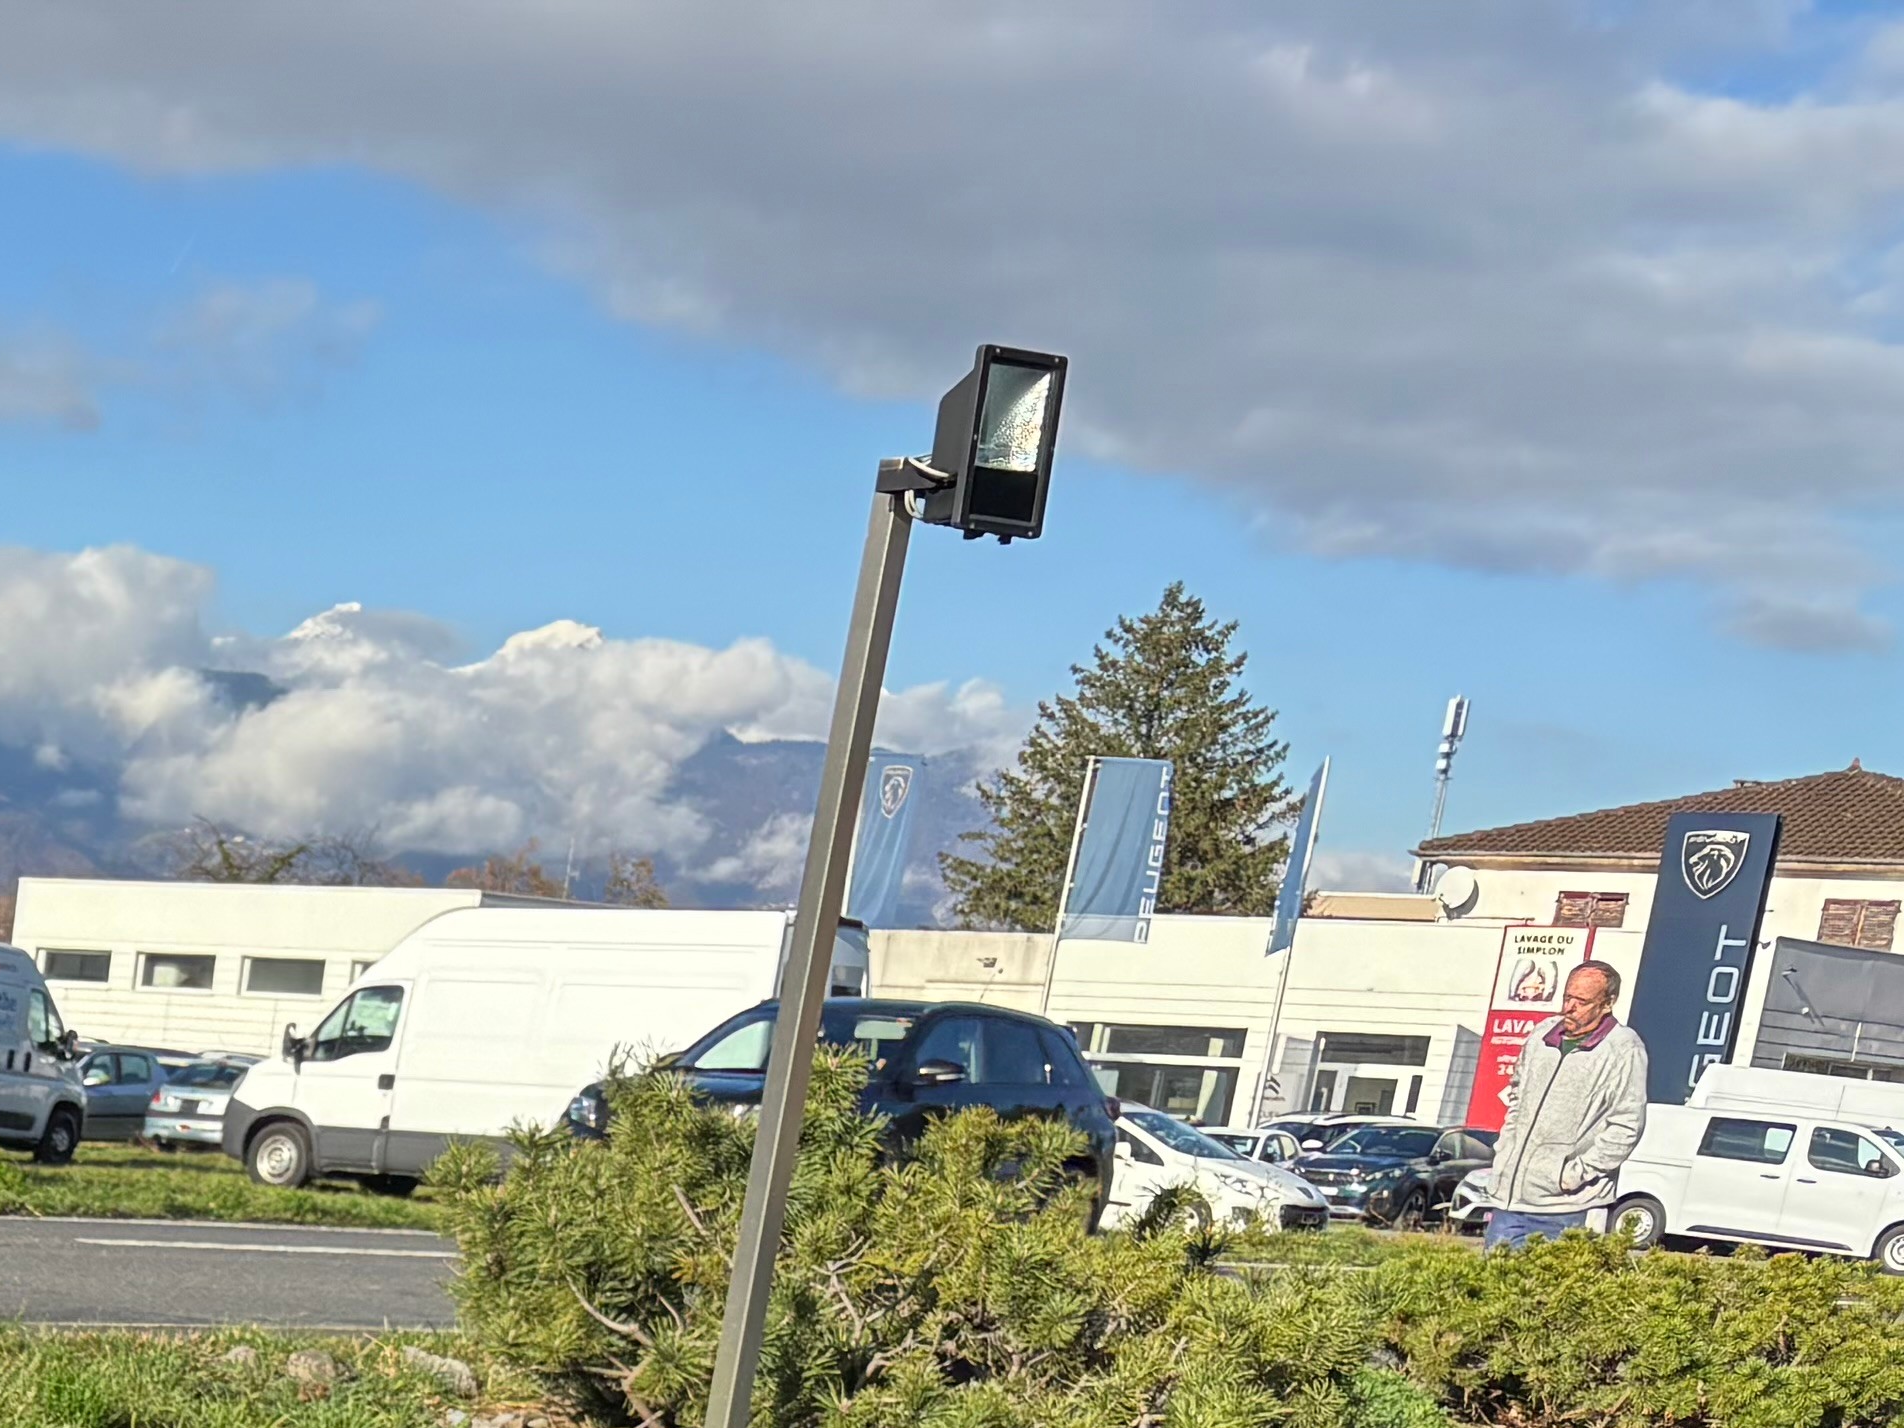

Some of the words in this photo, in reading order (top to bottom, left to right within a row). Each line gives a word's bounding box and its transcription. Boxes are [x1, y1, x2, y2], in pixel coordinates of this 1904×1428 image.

[1134, 766, 1174, 944] PEUGEOT
[1493, 1019, 1534, 1034] LAVA
[1687, 924, 1747, 1092] GEOT
